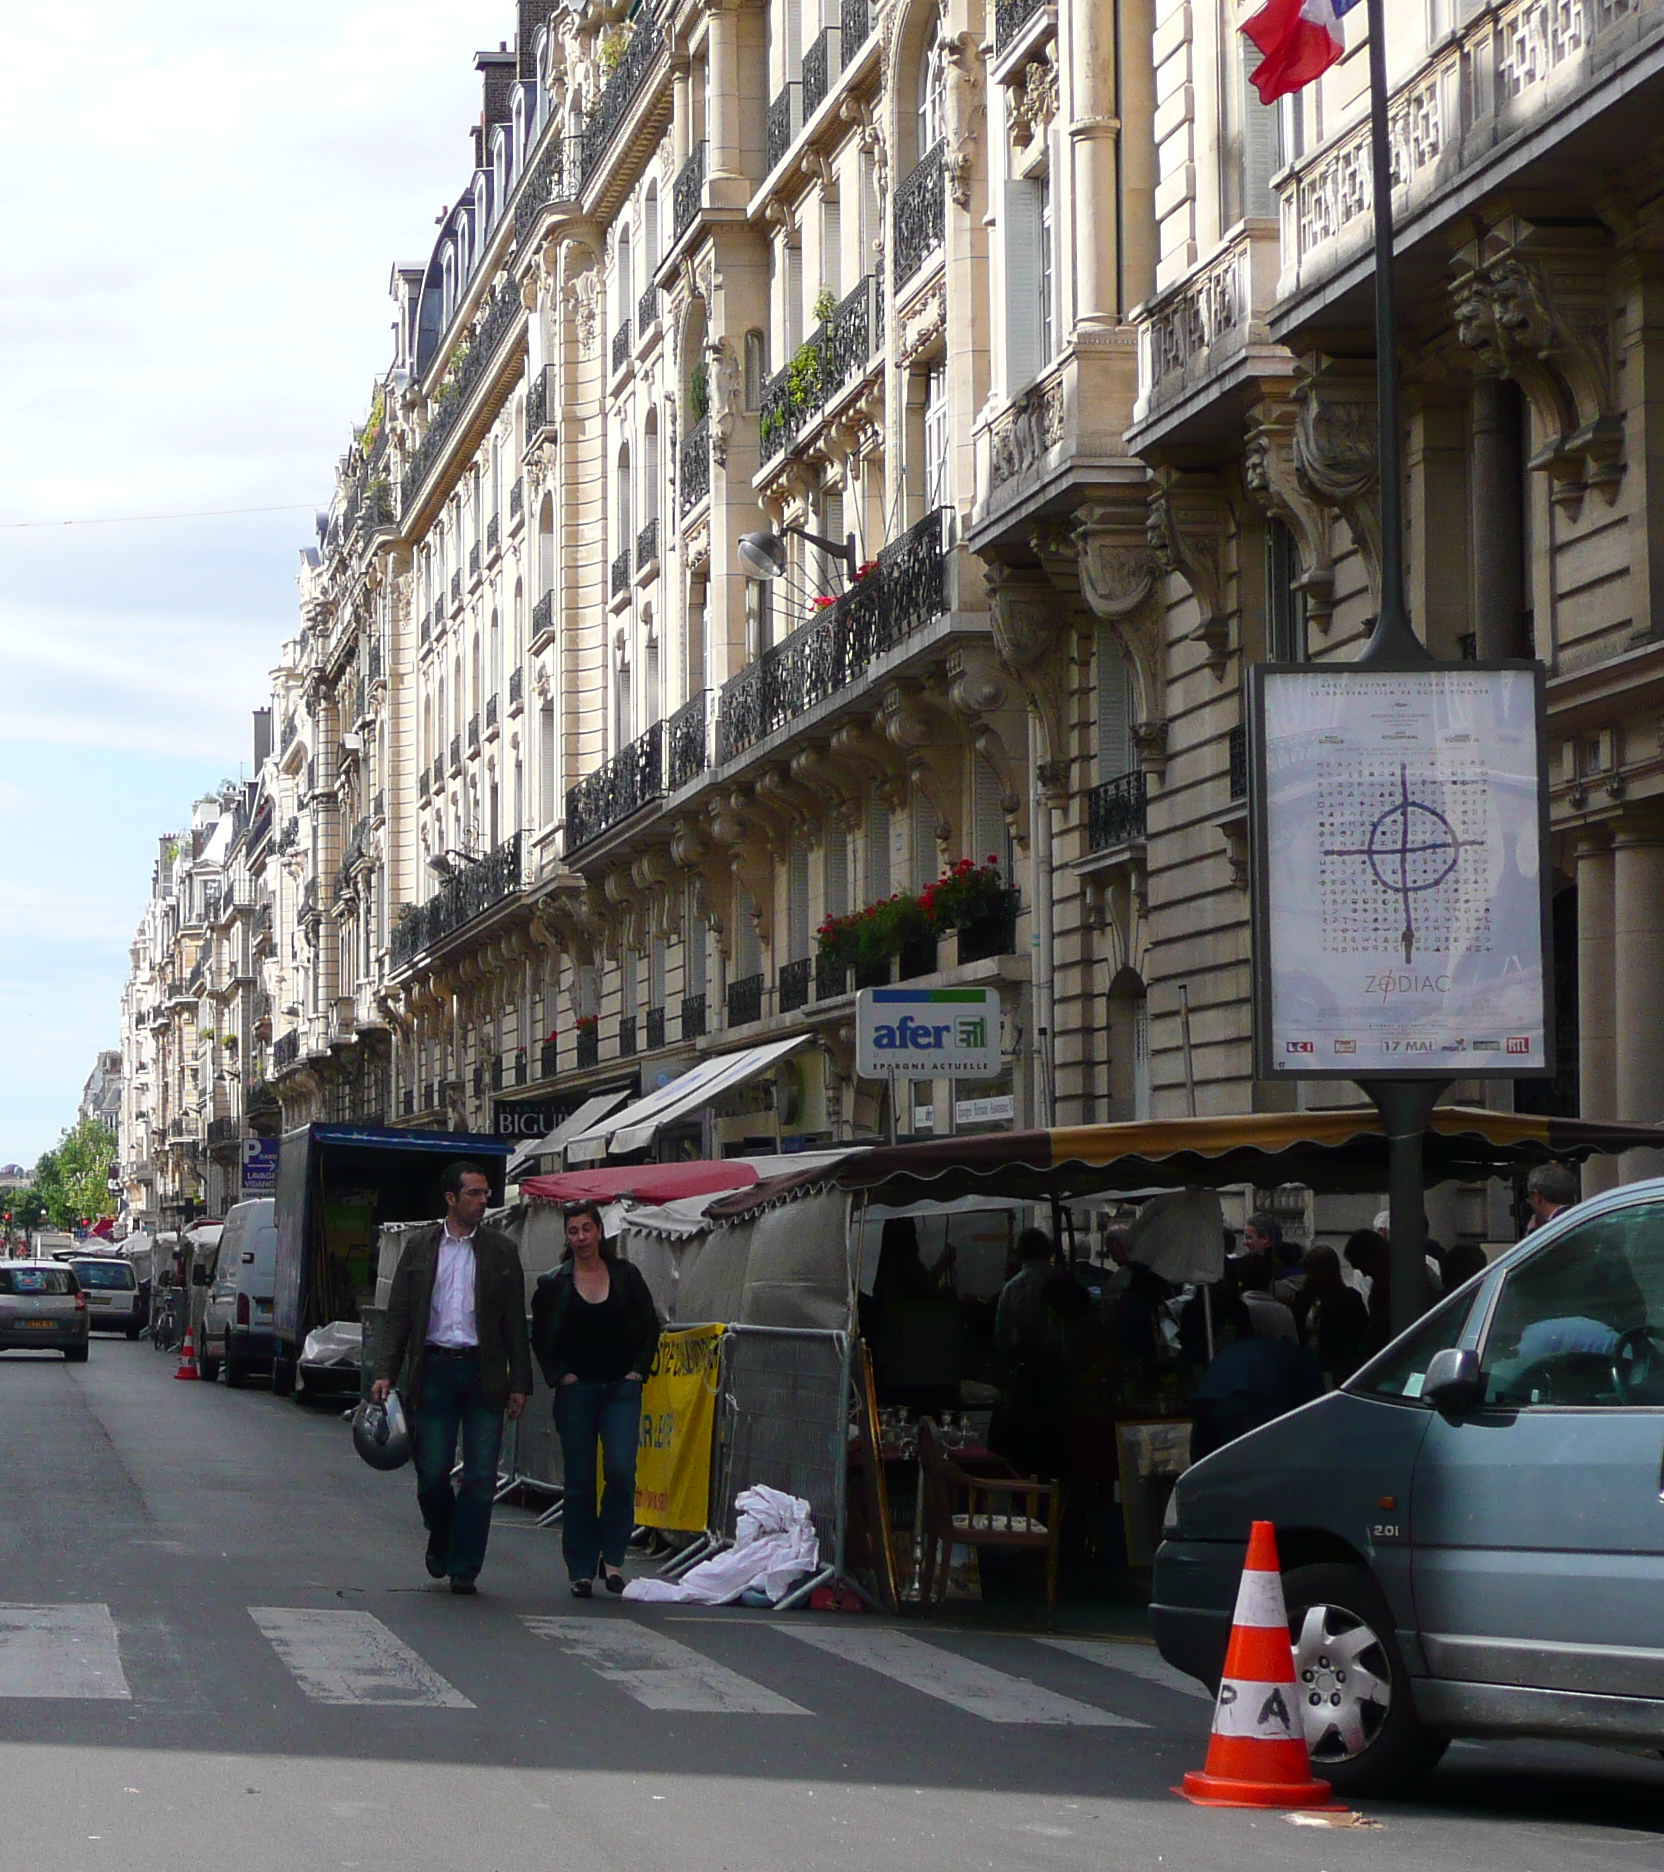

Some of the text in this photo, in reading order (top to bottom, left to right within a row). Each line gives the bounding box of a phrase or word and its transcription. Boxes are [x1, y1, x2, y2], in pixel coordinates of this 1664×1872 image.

[1365, 972, 1450, 1000] ZODIAC
[873, 1015, 950, 1049] afer
[1287, 1042, 1313, 1053] LCI
[1383, 1040, 1433, 1052] 17 MAI
[1508, 1039, 1528, 1053] RTL
[932, 1062, 989, 1071] ACTUELLE
[243, 1139, 262, 1164] P
[1257, 1687, 1291, 1731] A
